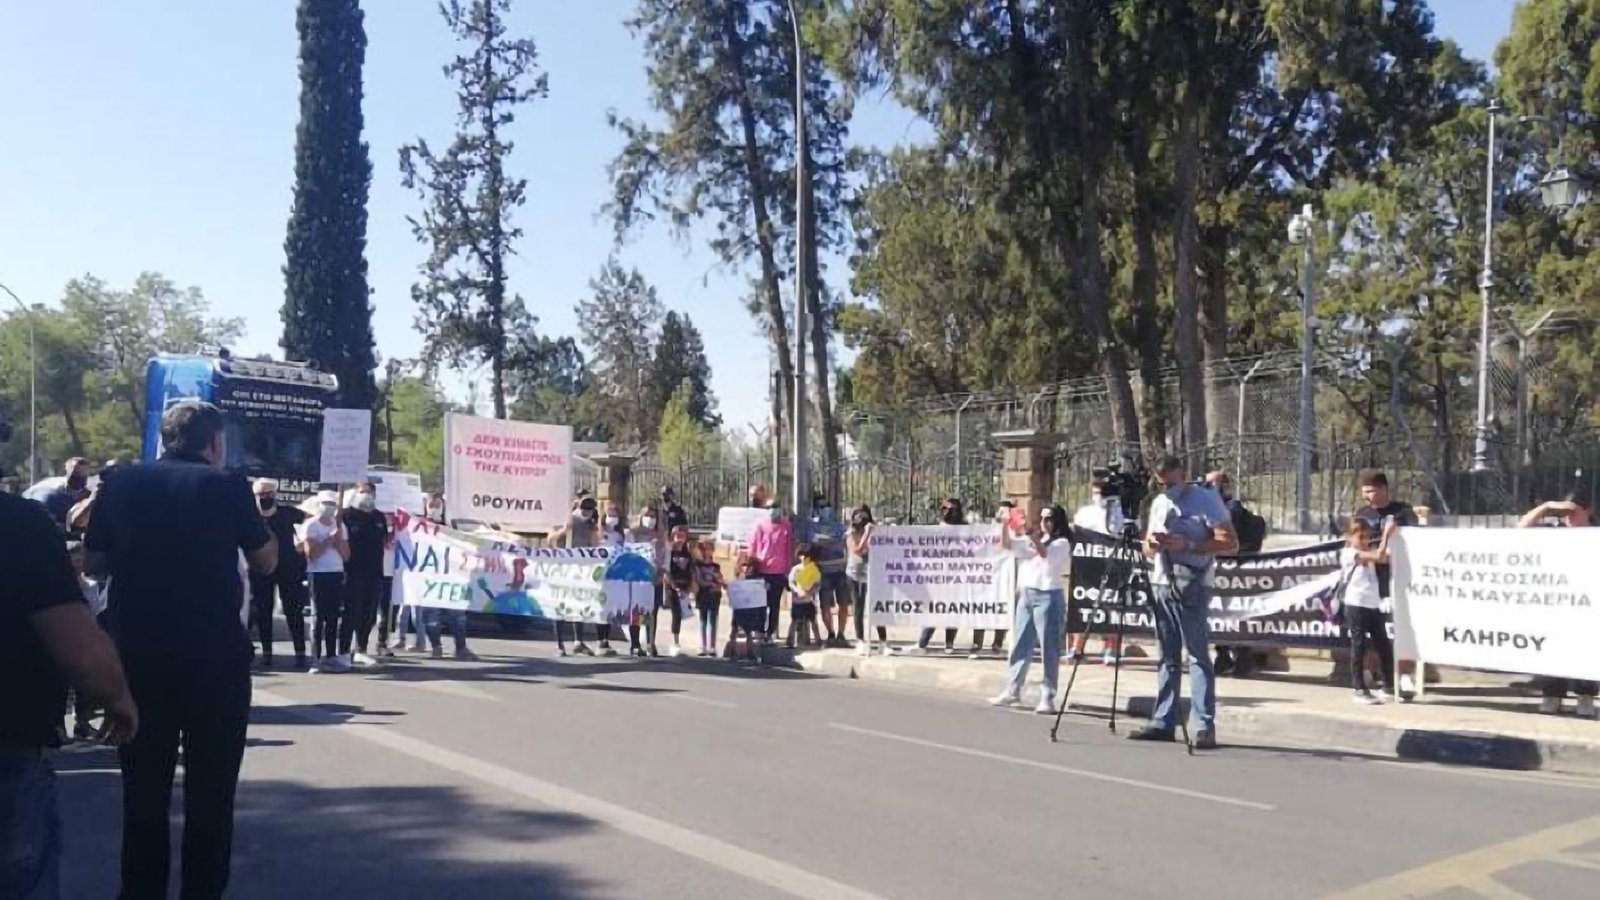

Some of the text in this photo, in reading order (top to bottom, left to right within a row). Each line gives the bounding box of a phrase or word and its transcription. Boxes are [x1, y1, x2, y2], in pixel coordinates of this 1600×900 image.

[473, 433, 500, 446] ΔΕΝ
[454, 444, 462, 455] Ο
[474, 461, 499, 473] ΤΗΣ
[472, 493, 543, 512] ΘΡΟΥΝΤΑ
[869, 535, 894, 546] ΔΕΝ
[897, 535, 914, 546] ΘΑ
[394, 540, 451, 575] ΝΑΙ
[903, 548, 975, 559] ΣΕ ΚΑΝΕΝΑ
[1444, 551, 1541, 567] ΛΕΜΕ ΟΧΙ
[885, 562, 993, 573] ΝΑ ΒΑΛΕΙ ΜΑΥΡΟ
[1421, 565, 1569, 586] ΣΤΗ ΔΥΣΟΣΜΙΑ
[887, 574, 993, 585] ΣΤΑ ΟΝΕΙΡΑ ΜΑΣ
[1407, 582, 1592, 607] ΚΑΙ ΤΑ ΚΑΥΣΑΕΡΙΑ
[874, 600, 1008, 616] ΑΓΙΟΣ ΙΩΑΝΝΗΣ
[1246, 620, 1340, 638] ΠΑΙΔΙΩΝ
[1443, 626, 1547, 652] ΚΛΗΡΟΥ
